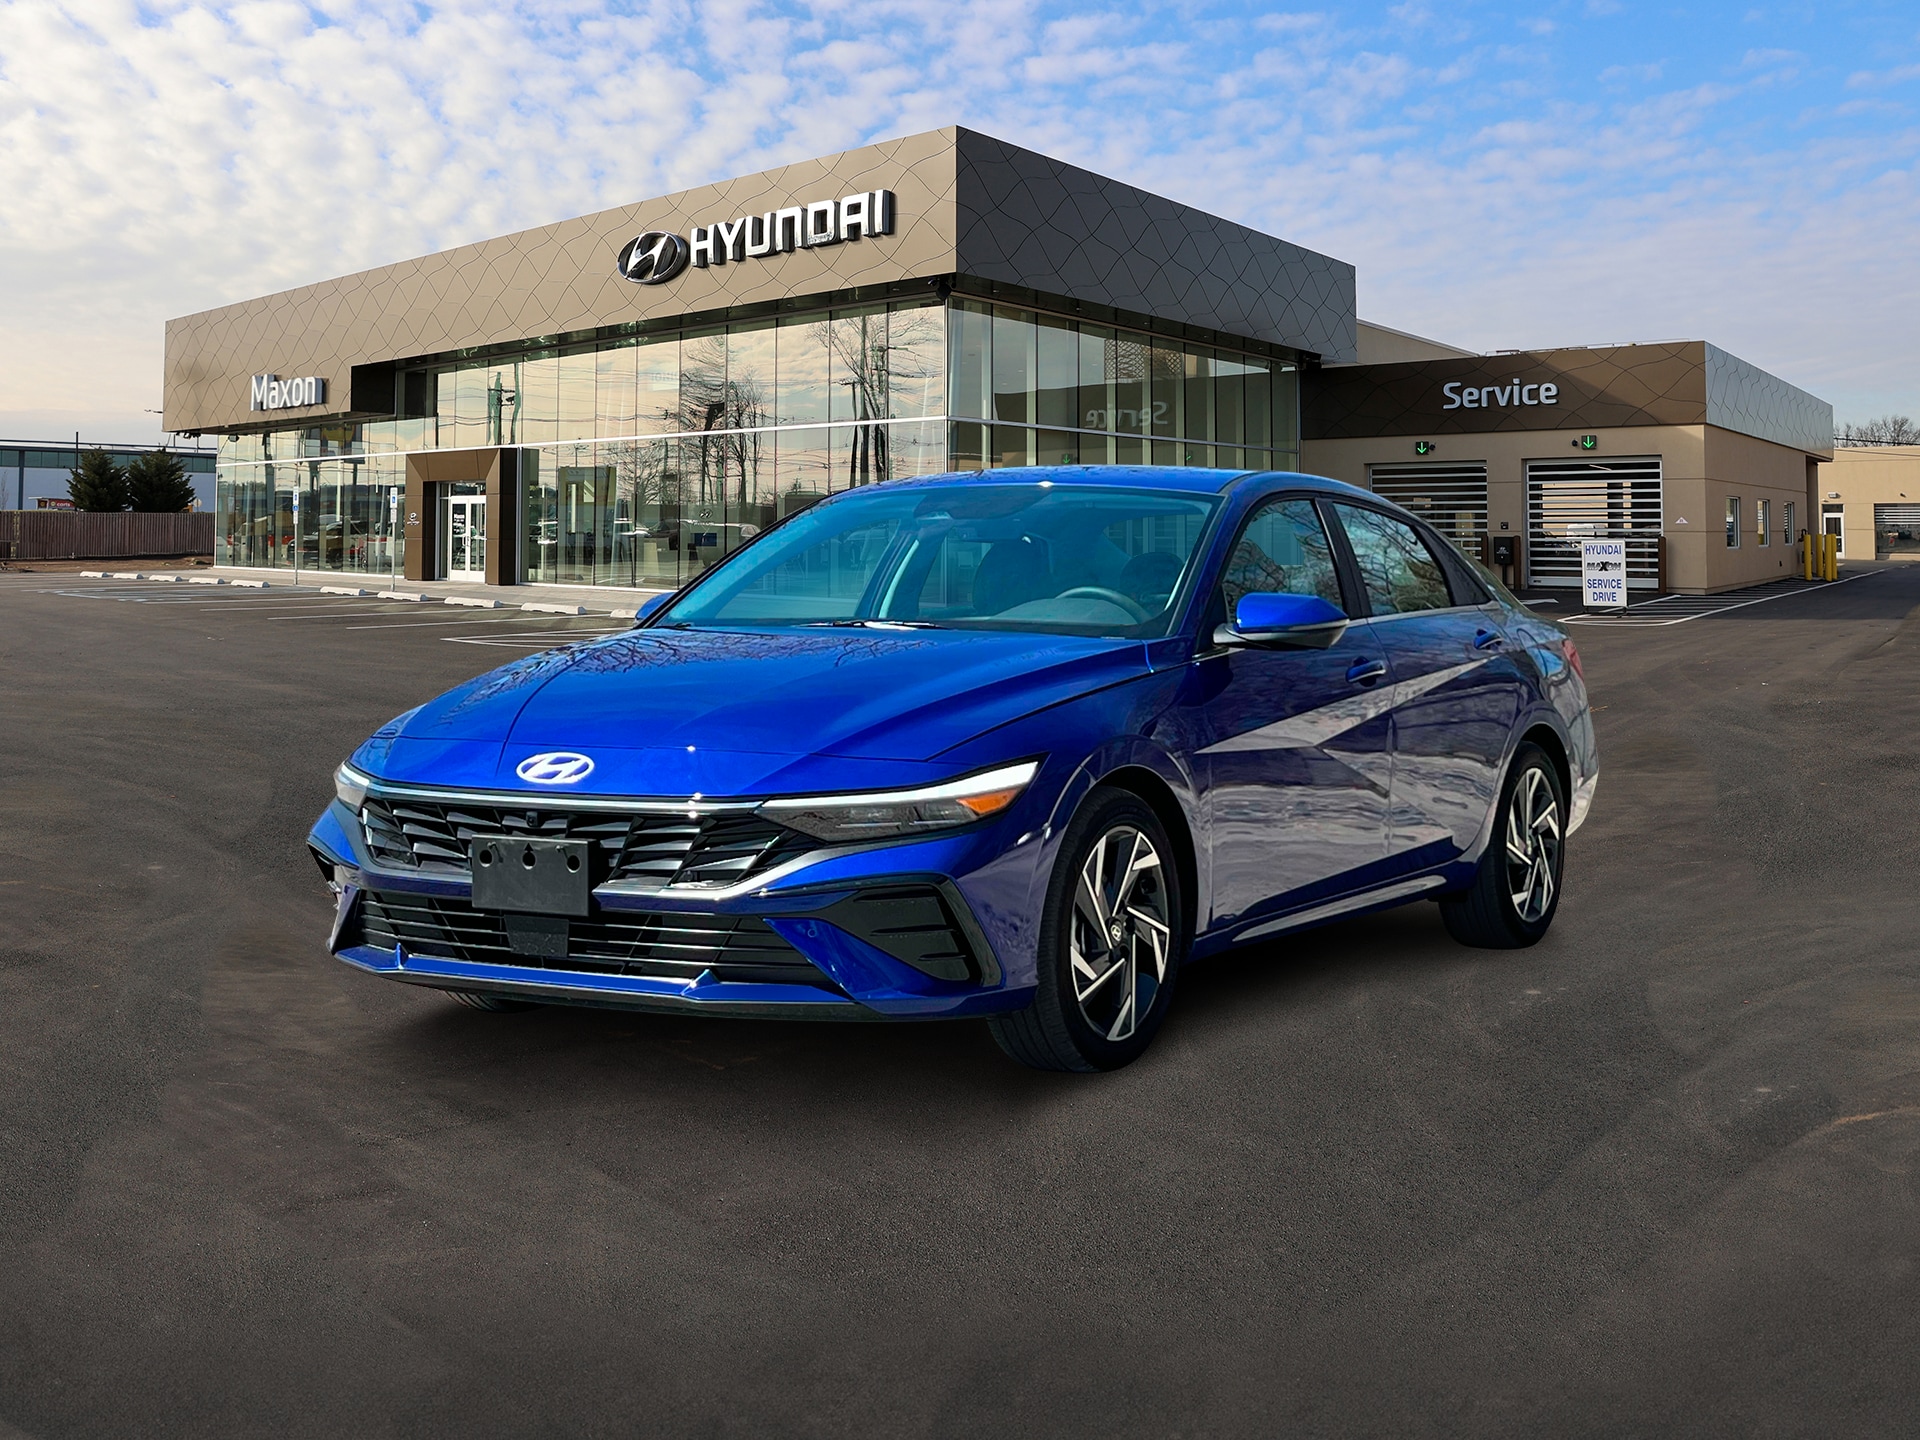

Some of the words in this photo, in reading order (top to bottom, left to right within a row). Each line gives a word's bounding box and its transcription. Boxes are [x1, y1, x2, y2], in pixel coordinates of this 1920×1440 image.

[690, 189, 892, 268] HYUNDAI
[250, 374, 320, 411] Maxon
[1443, 378, 1558, 409] Service
[1585, 545, 1622, 555] HYUNDAI
[1587, 579, 1622, 589] SERVICE
[1593, 592, 1617, 602] DRIVE
